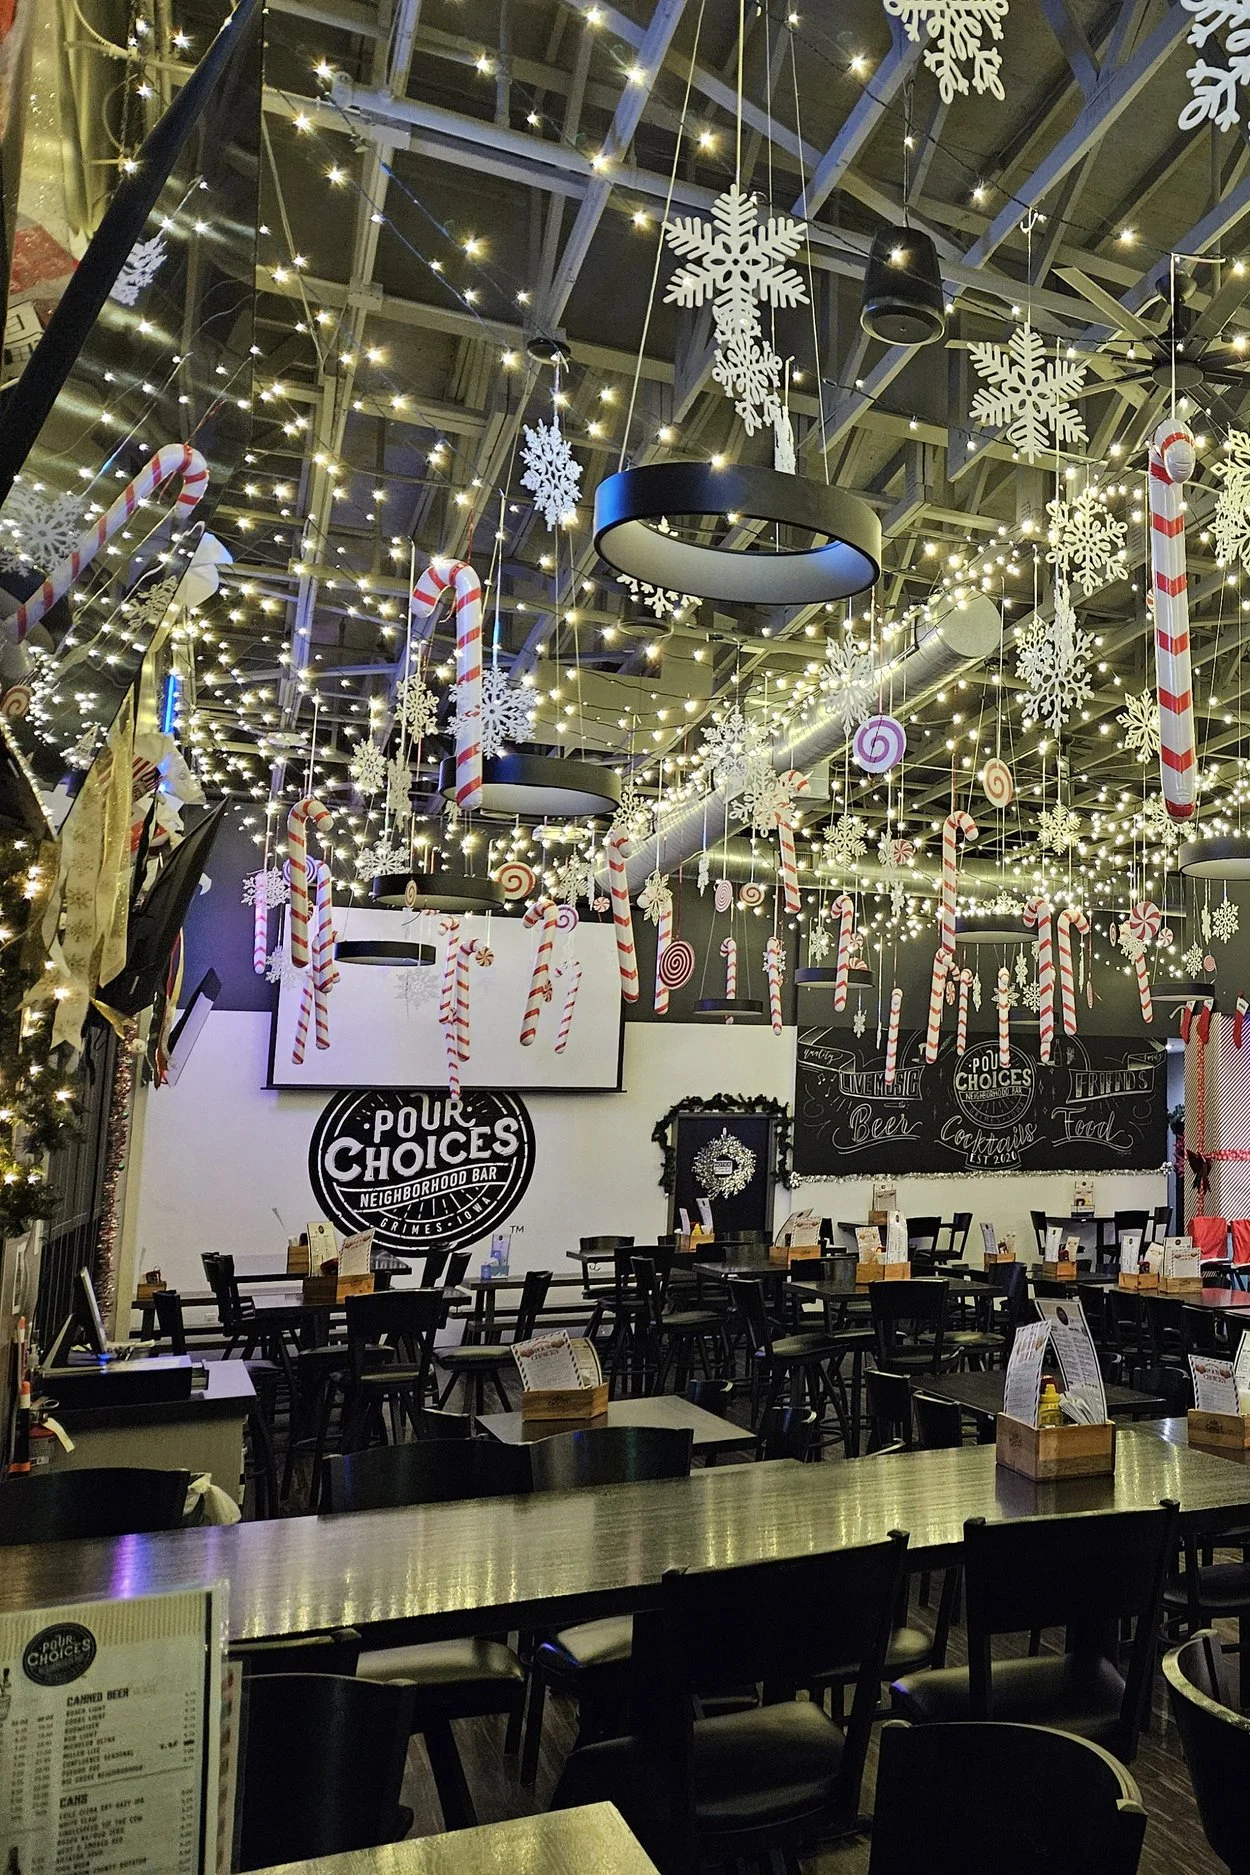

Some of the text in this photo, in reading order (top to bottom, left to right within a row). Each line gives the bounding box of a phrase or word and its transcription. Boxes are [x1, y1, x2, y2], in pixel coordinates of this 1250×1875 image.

[841, 1069, 920, 1097] LIVE MUSIC
[955, 1068, 1032, 1091] CHOICES
[1075, 1070, 1148, 1098] FRIENDS
[373, 1092, 476, 1143] POUR
[850, 1103, 923, 1142] Beer
[1051, 1107, 1125, 1141] Food
[324, 1116, 520, 1182] CHOICES
[941, 1115, 1038, 1155] Cocktails
[970, 1152, 990, 1165] EST
[360, 1166, 497, 1208] NEIGHBORHOOD BAR
[380, 1197, 491, 1234] GRIMES IOWA
[510, 1226, 524, 1234] TM
[27, 1638, 91, 1666] CHOICES
[42, 1634, 73, 1654] POUR
[66, 1687, 129, 1707] CANNED BEER
